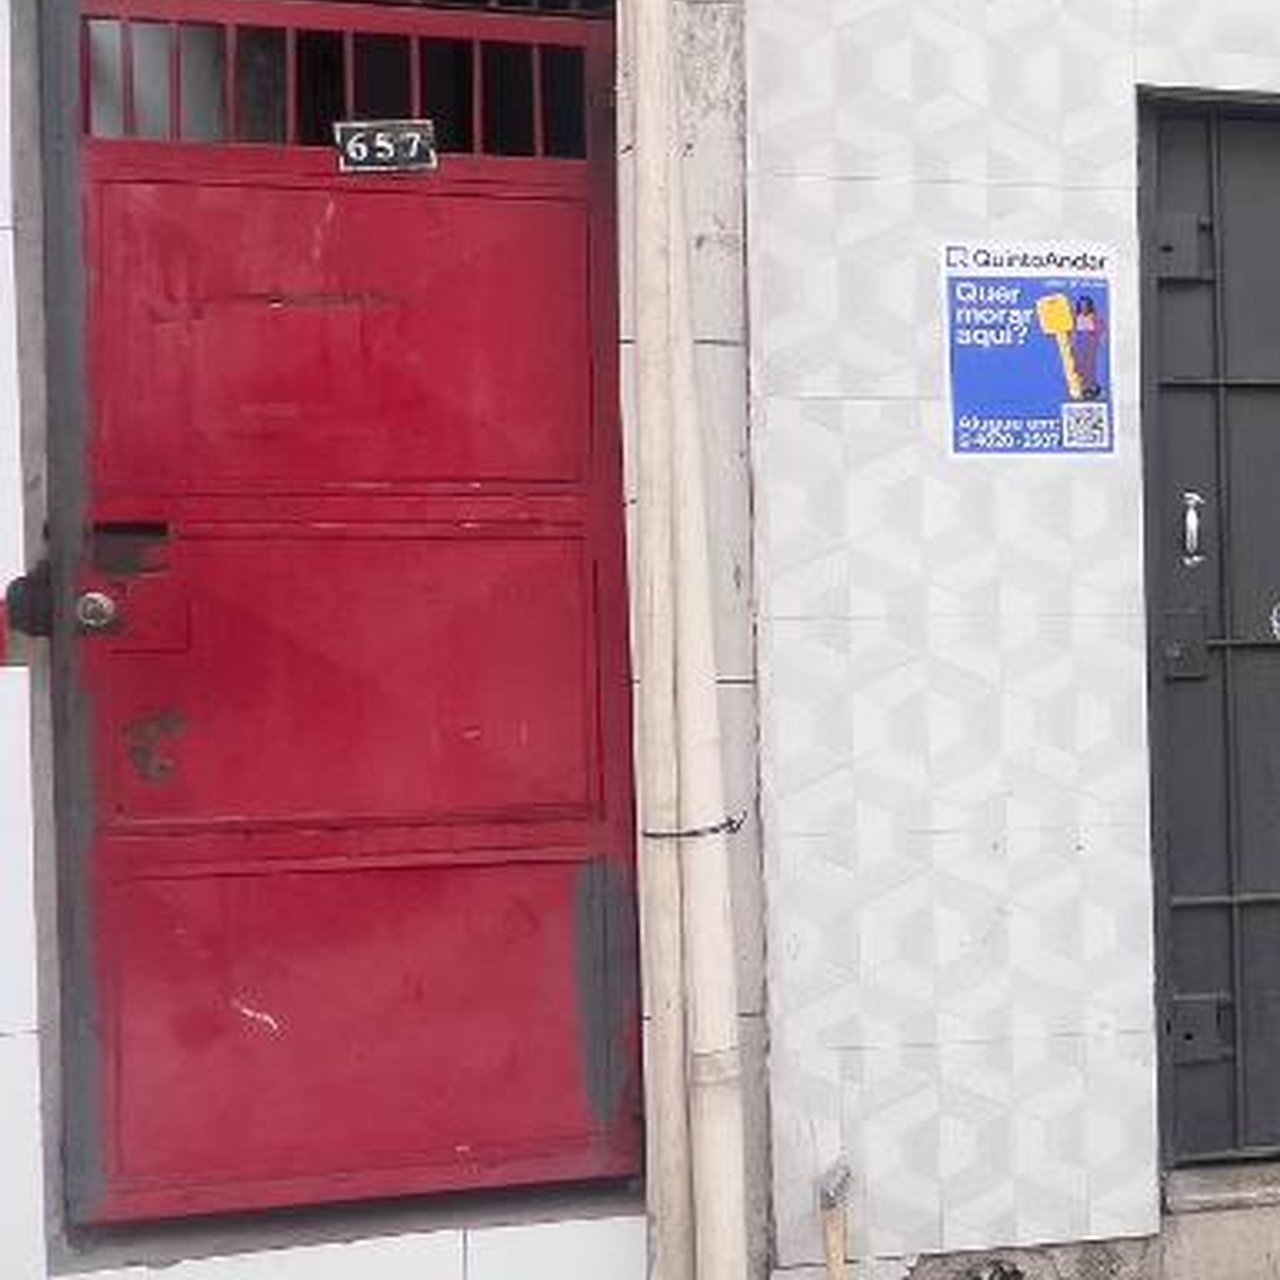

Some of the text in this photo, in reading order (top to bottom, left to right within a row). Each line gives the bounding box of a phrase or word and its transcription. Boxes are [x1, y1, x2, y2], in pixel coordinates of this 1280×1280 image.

[346, 131, 421, 160] 657
[972, 247, 1111, 271] QuintoAndar
[955, 282, 1022, 304] Quer
[955, 308, 1035, 326] morar
[955, 323, 1031, 347] aqui?
